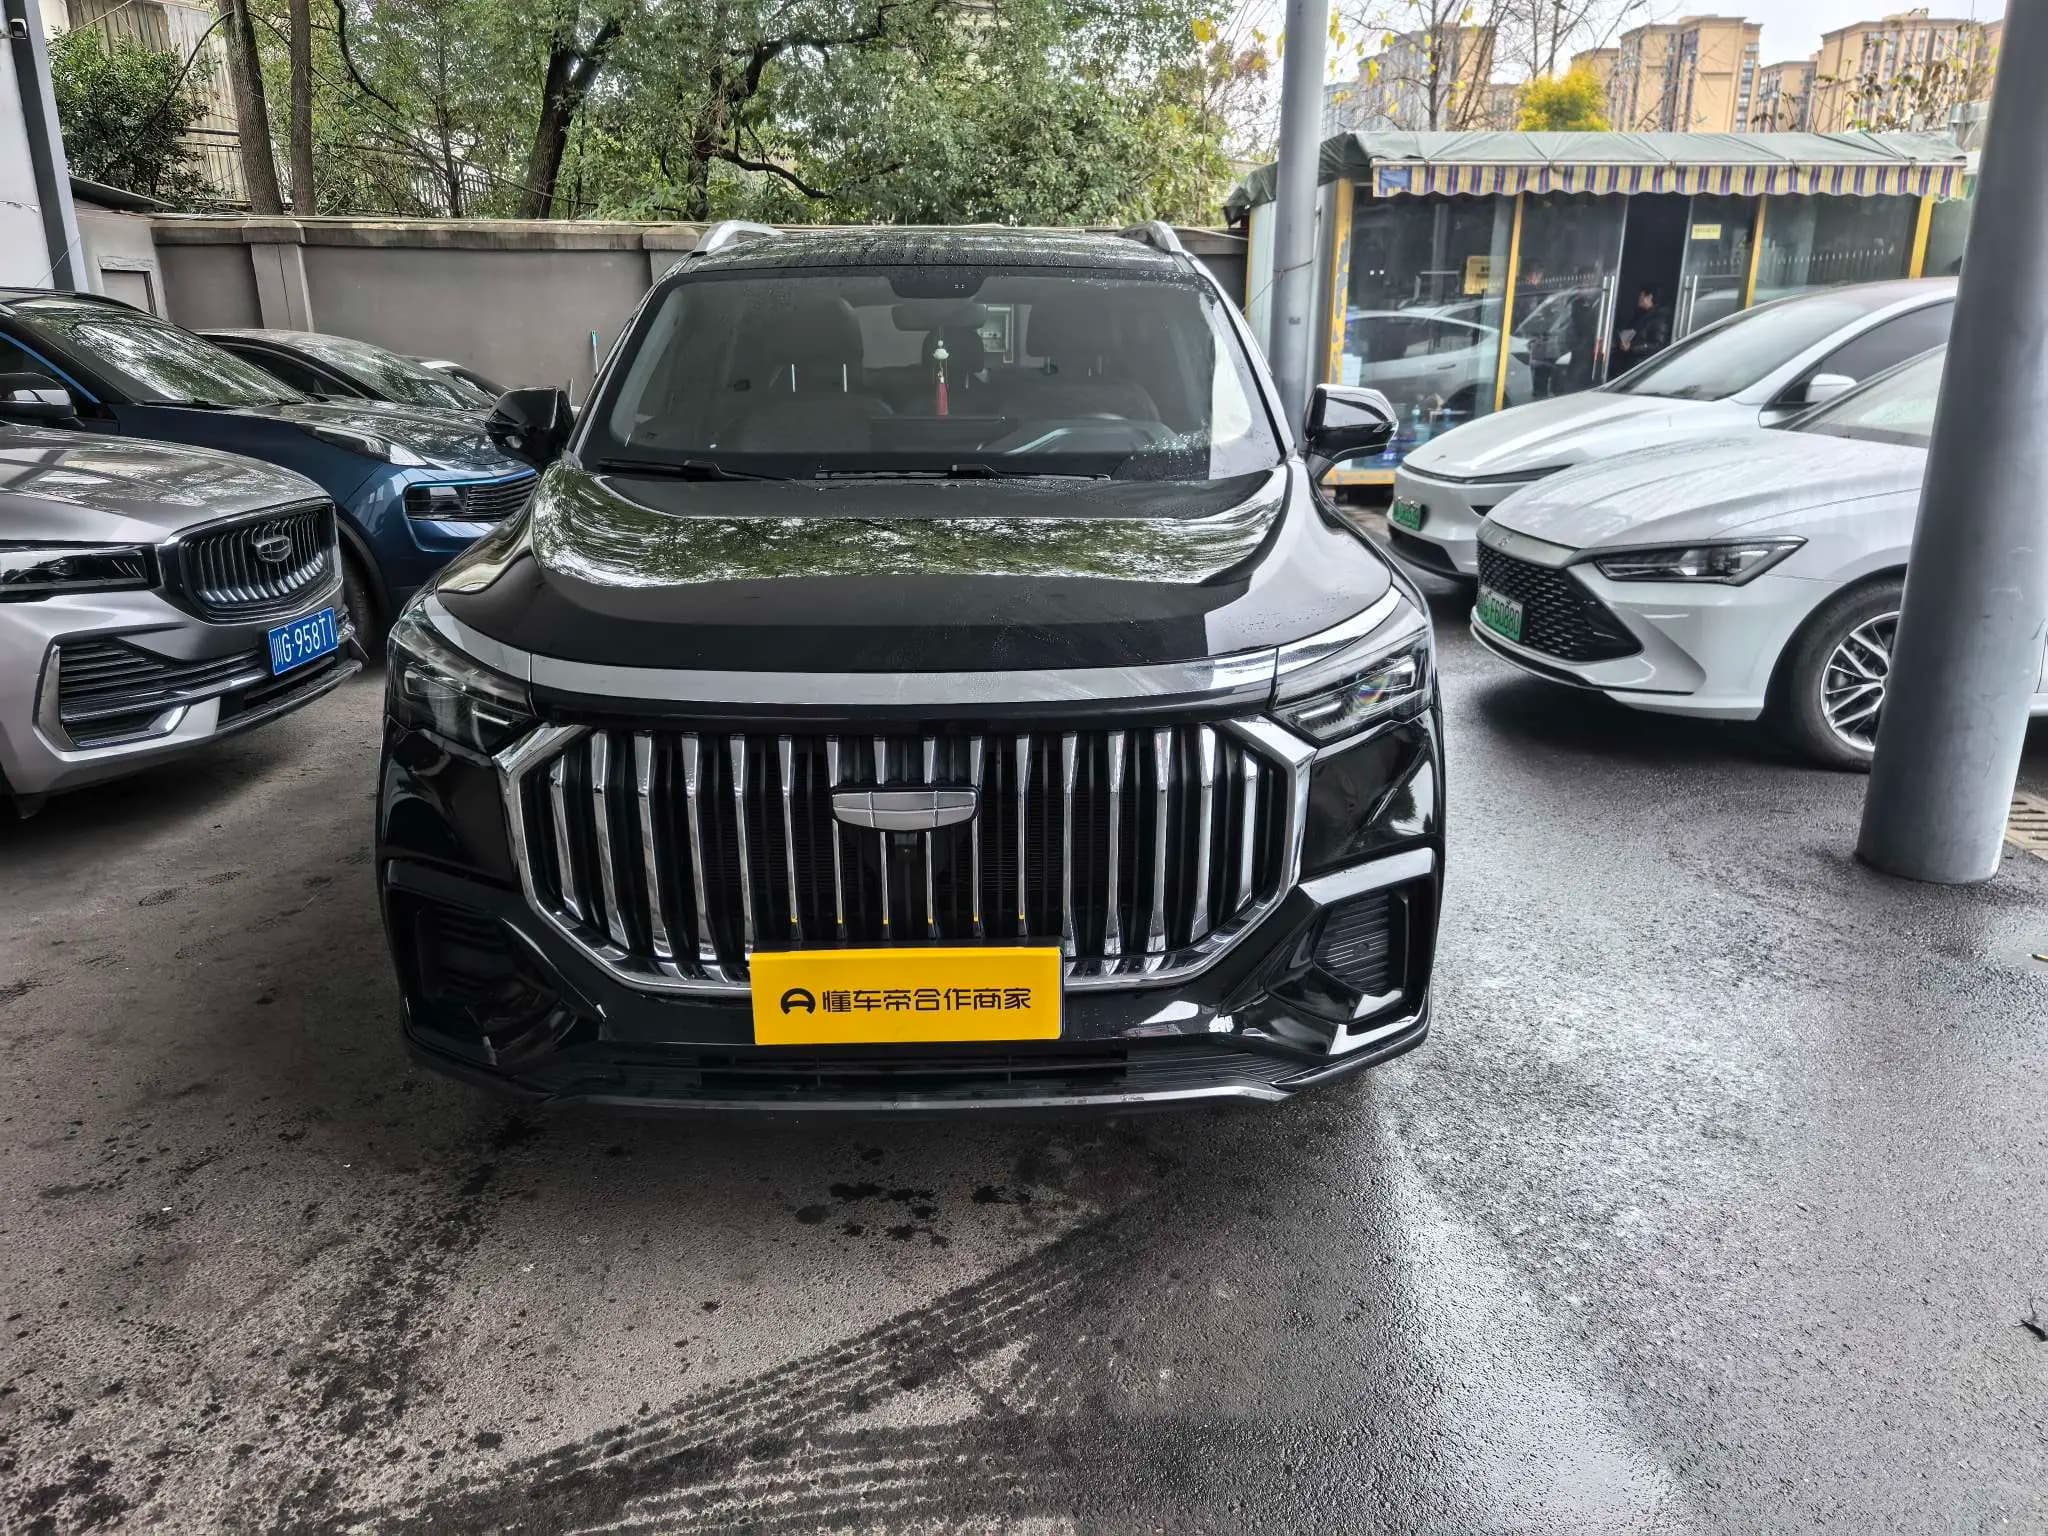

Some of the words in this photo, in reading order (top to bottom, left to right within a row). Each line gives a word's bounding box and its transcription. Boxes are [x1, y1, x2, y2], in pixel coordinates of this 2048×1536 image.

[822, 987, 1031, 1012] 懂车帝合作商家
